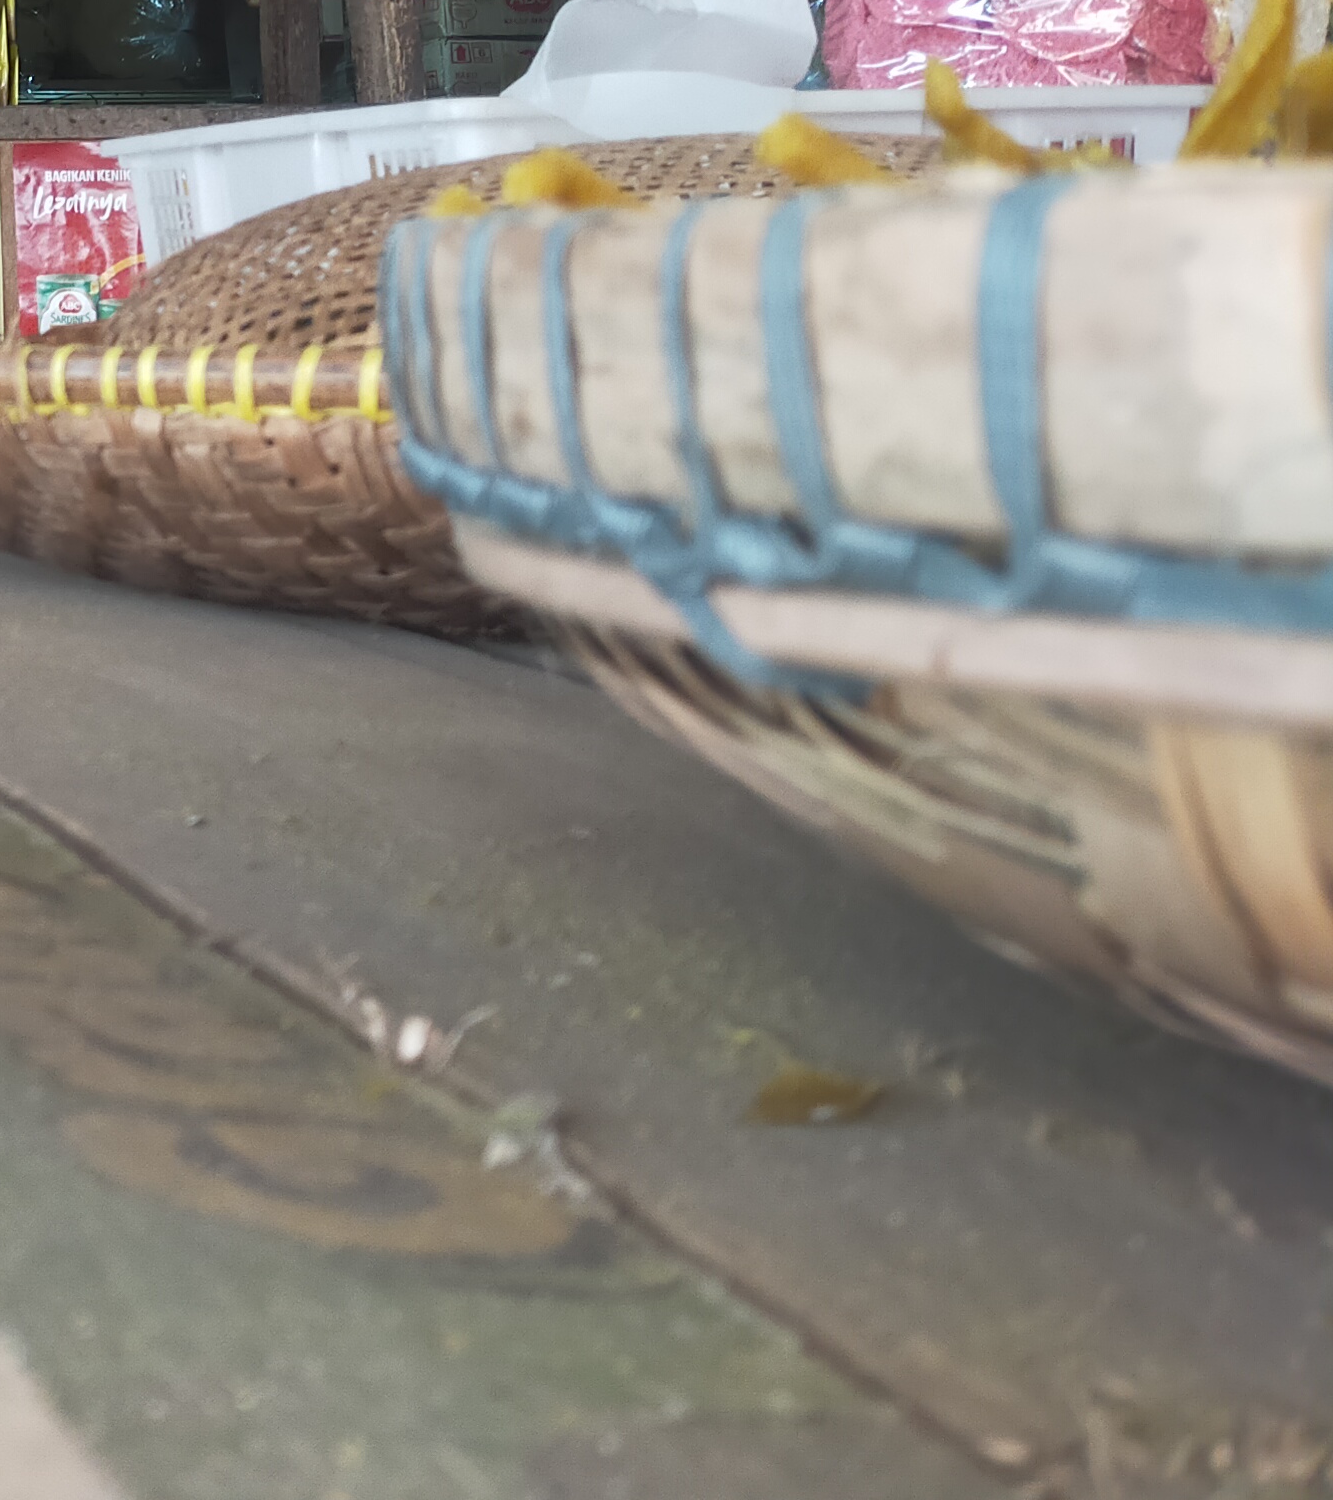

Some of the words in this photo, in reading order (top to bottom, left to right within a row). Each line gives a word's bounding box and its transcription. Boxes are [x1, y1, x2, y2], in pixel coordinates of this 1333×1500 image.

[44, 169, 95, 183] BAGIKAN
[32, 187, 128, 221] Lezatnya
[60, 300, 82, 312] ABC
[50, 311, 92, 326] SARDINES
